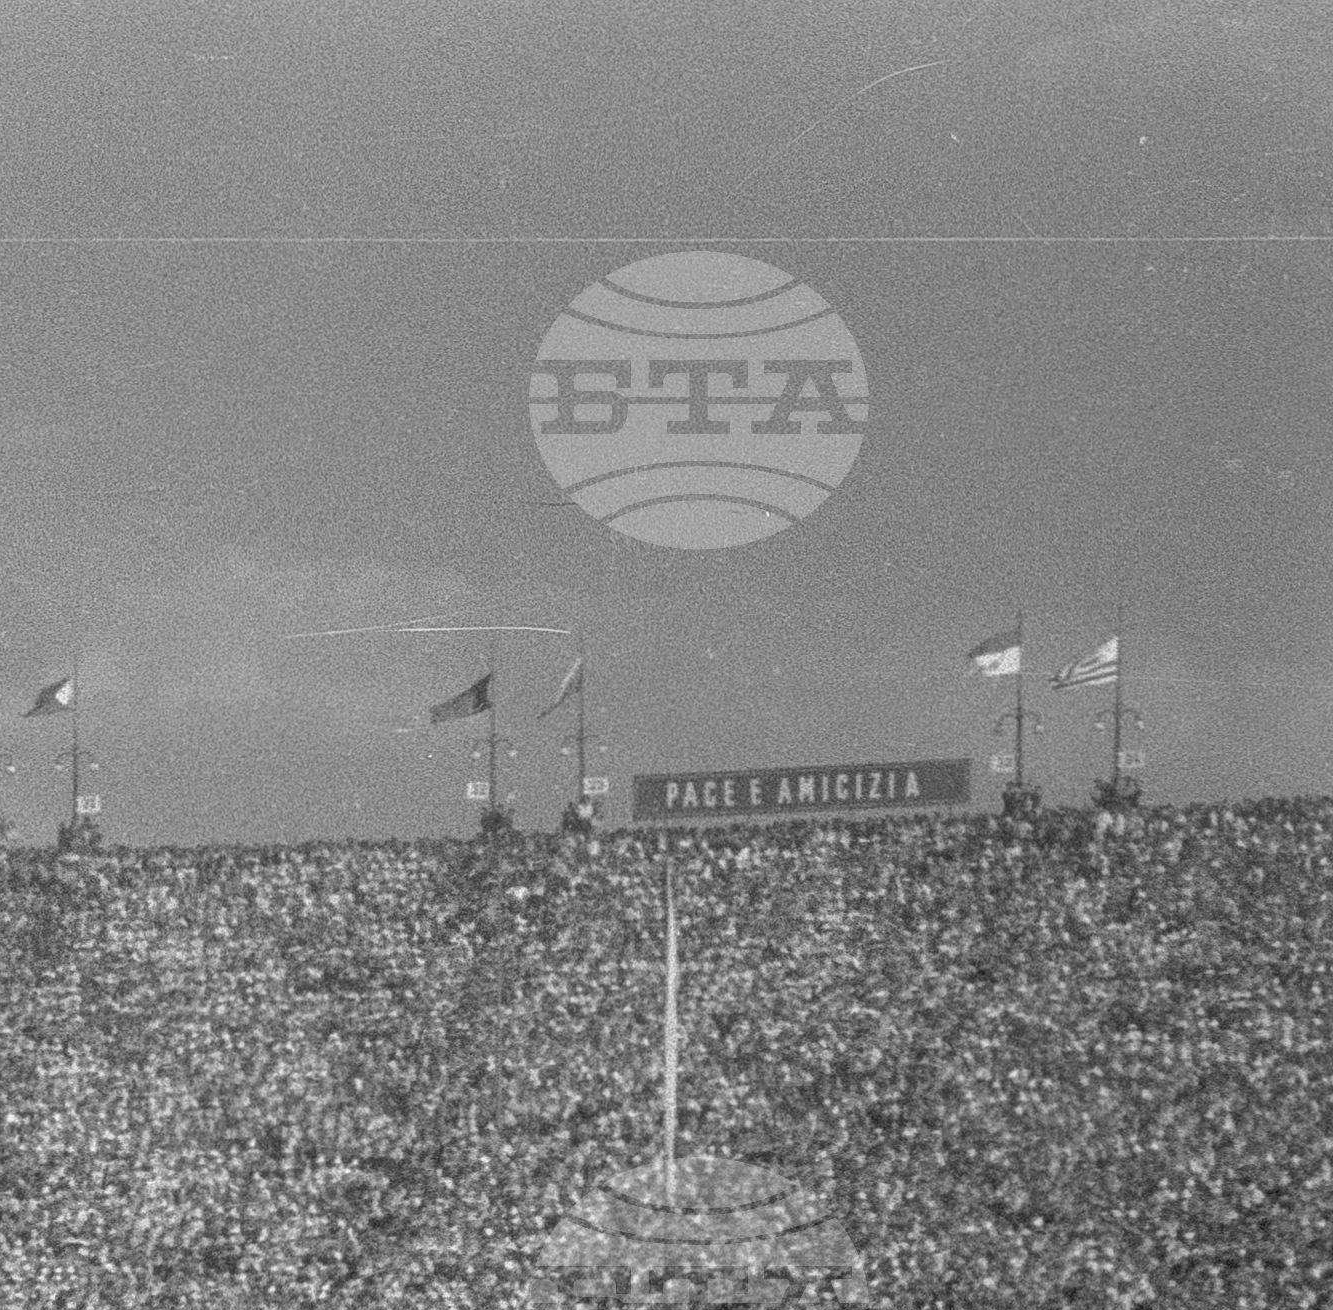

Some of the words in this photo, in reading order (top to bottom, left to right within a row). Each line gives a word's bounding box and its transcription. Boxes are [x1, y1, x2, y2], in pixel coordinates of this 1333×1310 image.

[665, 780, 735, 808] PACE
[749, 777, 763, 806] E
[778, 772, 921, 804] AMICIZIA
